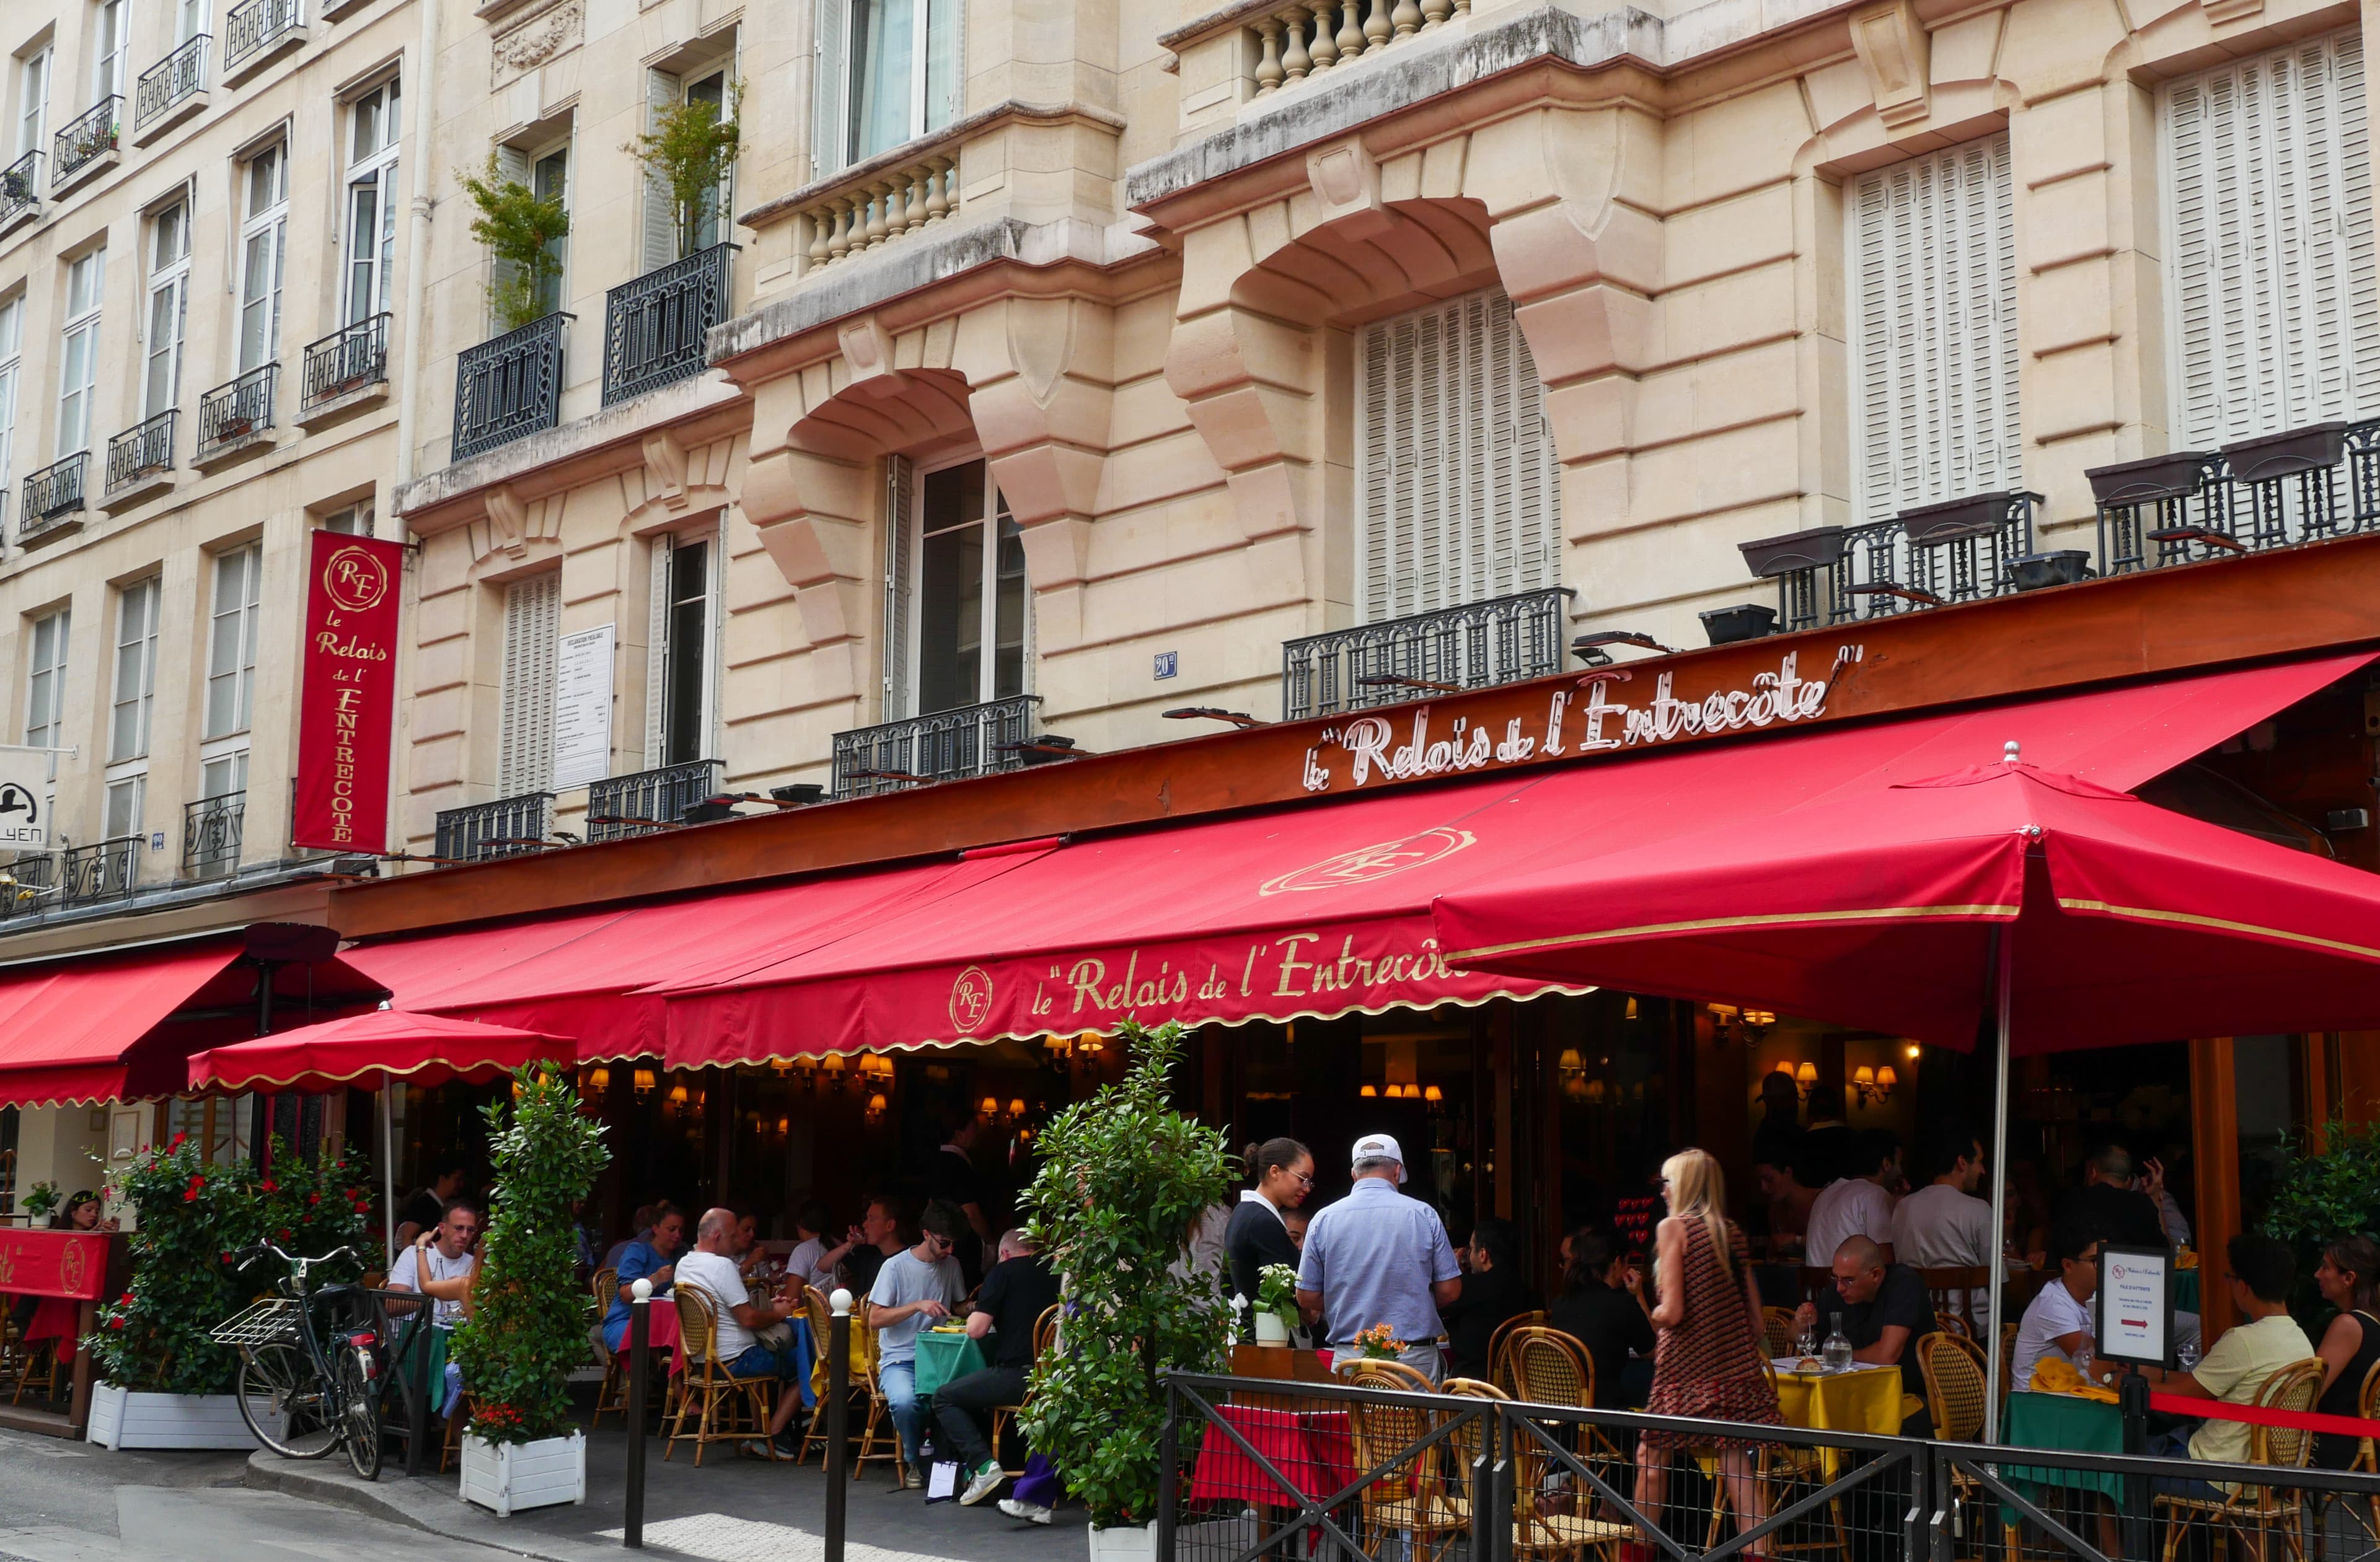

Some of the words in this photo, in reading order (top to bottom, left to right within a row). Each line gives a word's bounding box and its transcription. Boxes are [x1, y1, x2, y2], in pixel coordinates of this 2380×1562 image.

[326, 610, 342, 627] le
[315, 631, 387, 661] Relais
[332, 669, 349, 682] de
[330, 688, 363, 844] ENTRECOTE
[1303, 747, 1329, 791] le
[1496, 717, 1535, 763] de
[1031, 981, 1053, 1016] le
[1197, 963, 1227, 1000] de
